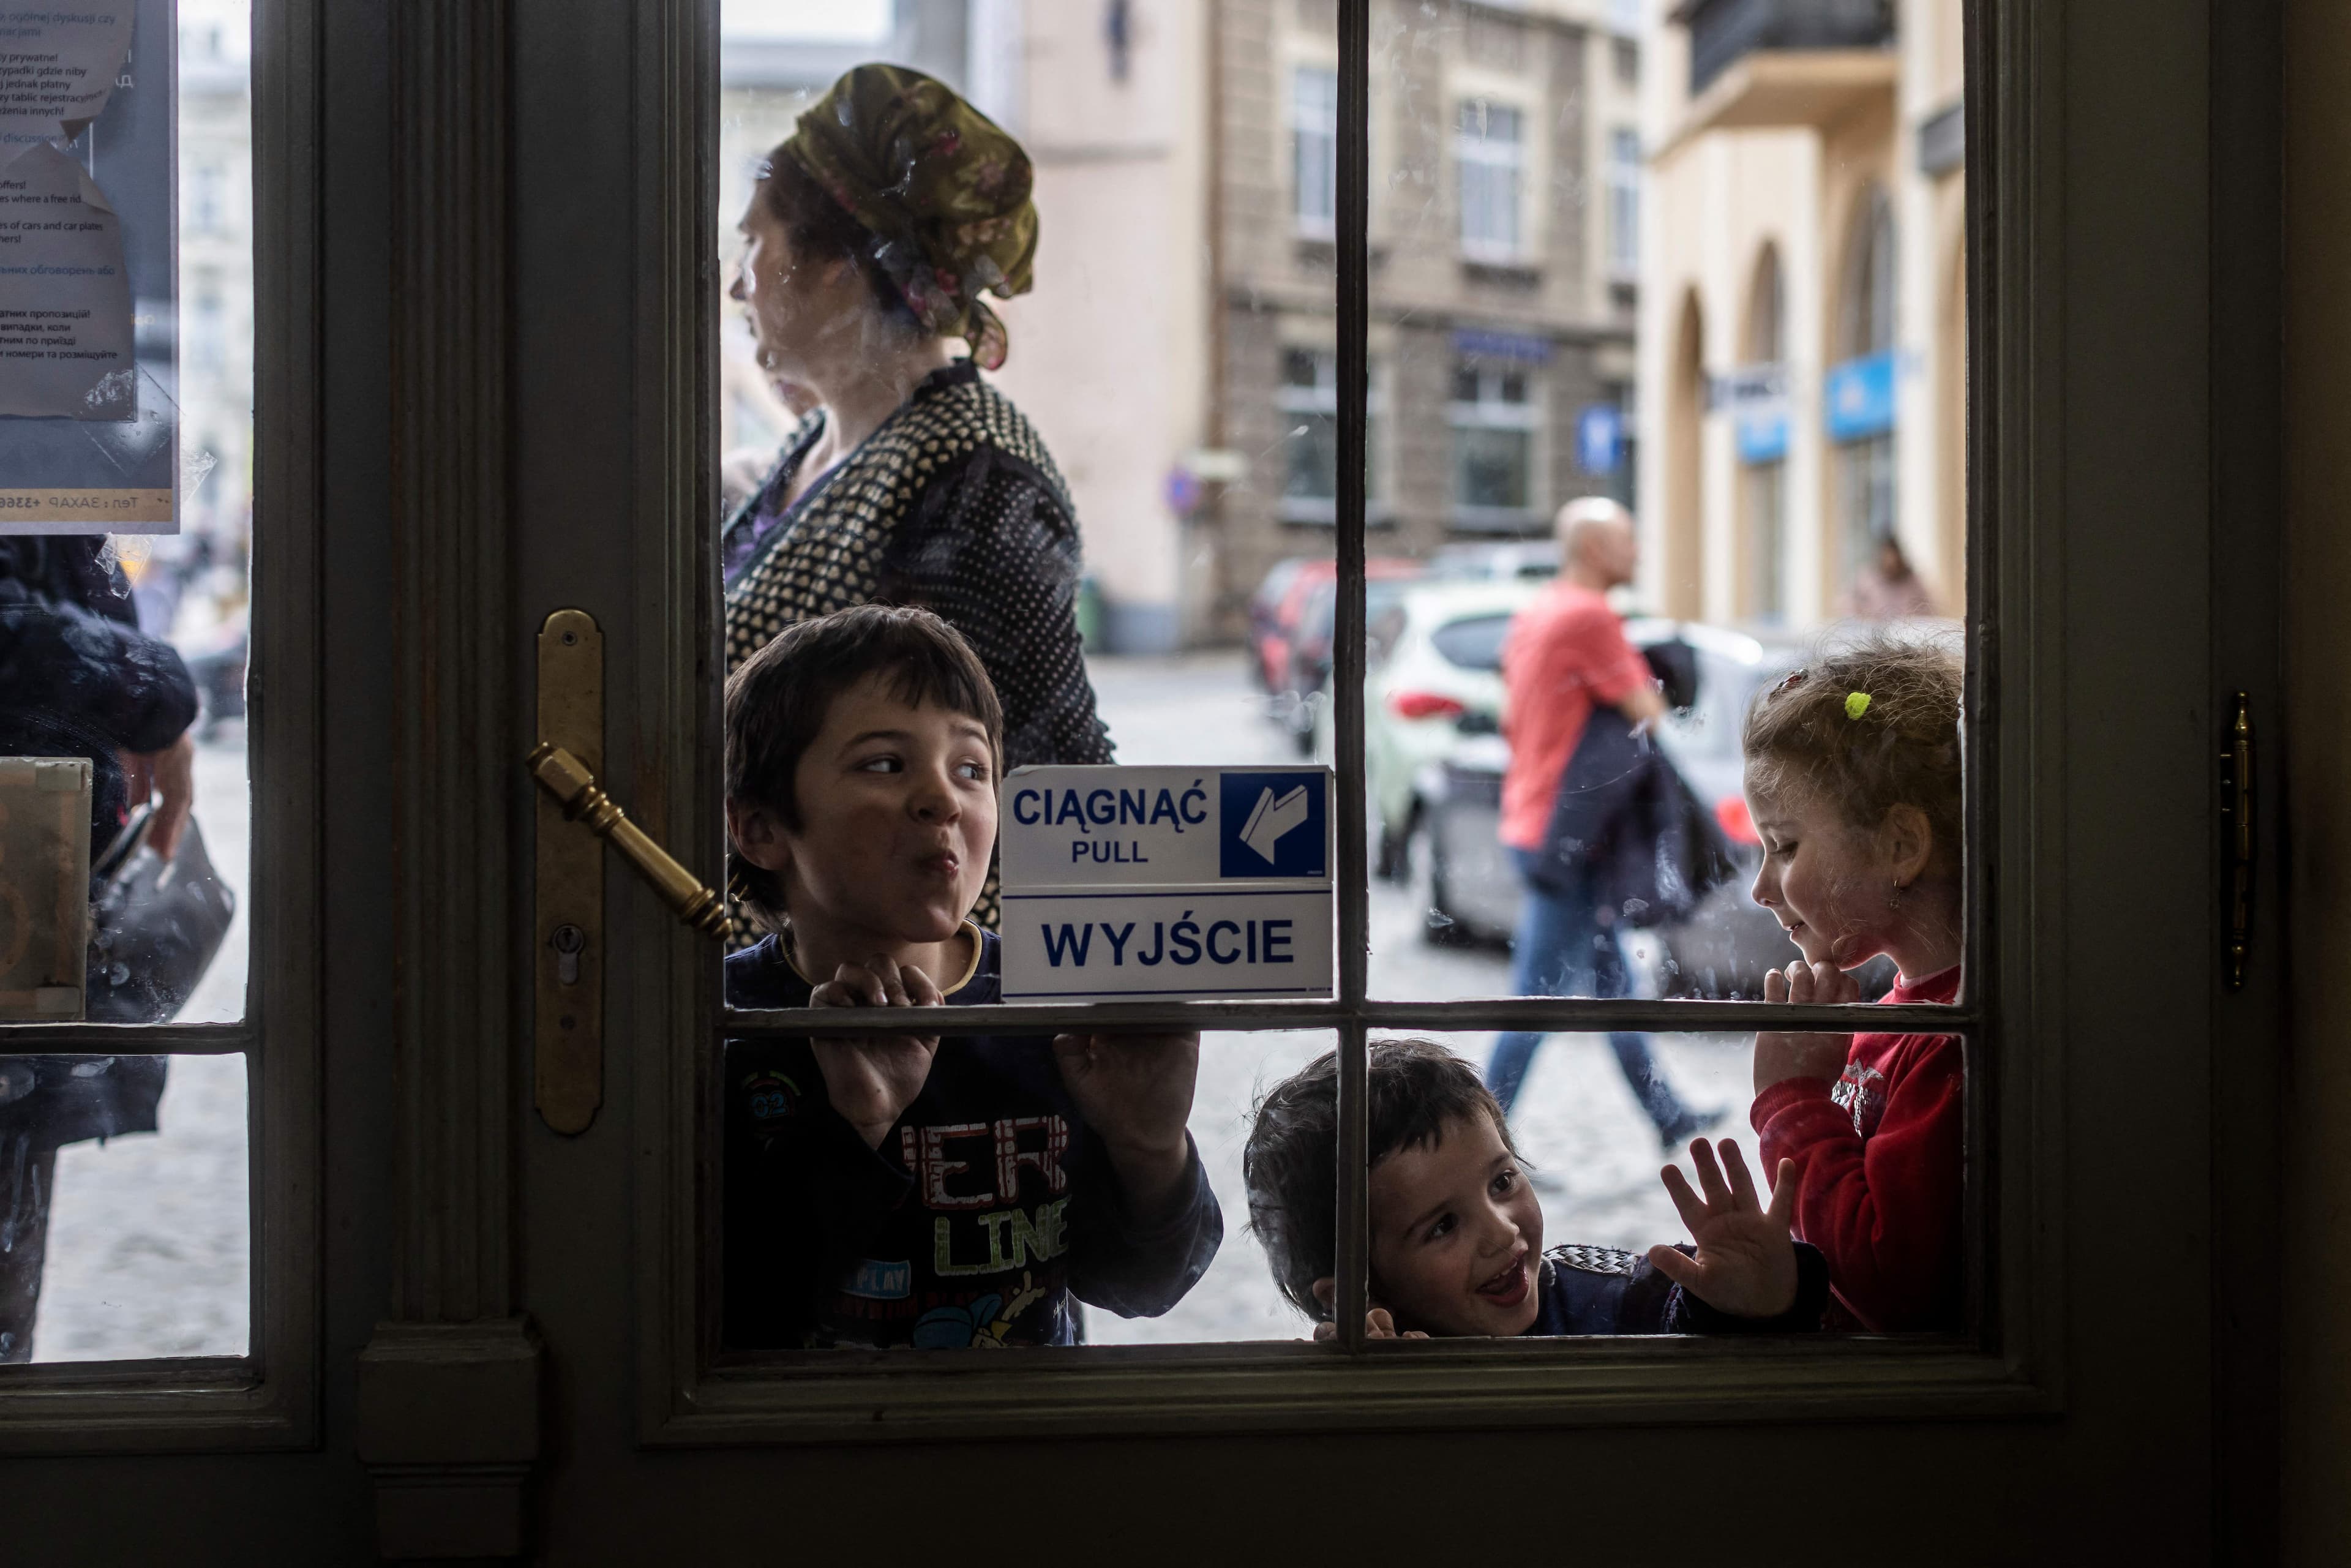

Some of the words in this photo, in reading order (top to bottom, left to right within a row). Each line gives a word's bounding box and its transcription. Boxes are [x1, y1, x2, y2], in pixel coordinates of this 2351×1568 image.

[97, 15, 116, 25] czy
[9, 53, 58, 64] prywatne!
[37, 67, 62, 77] gdzie
[66, 67, 87, 78] niby
[6, 80, 38, 89] jednak
[12, 92, 38, 102] tablic
[30, 107, 64, 117] innych!
[12, 193, 41, 203] where
[51, 193, 67, 203] free
[70, 194, 81, 203] rid
[10, 221, 20, 230] of
[43, 221, 61, 230] and
[29, 310, 91, 320] пропозицій!
[1, 324, 45, 332] випадки,
[40, 337, 76, 347] приїзді
[6, 351, 44, 360] номери
[59, 350, 118, 362] розміщуйте
[1013, 779, 1207, 833] CIĄGNĄĆ
[1072, 841, 1149, 863] PULL
[1041, 910, 1294, 967] WYJŚCIE
[934, 1194, 1073, 1277] LINE
